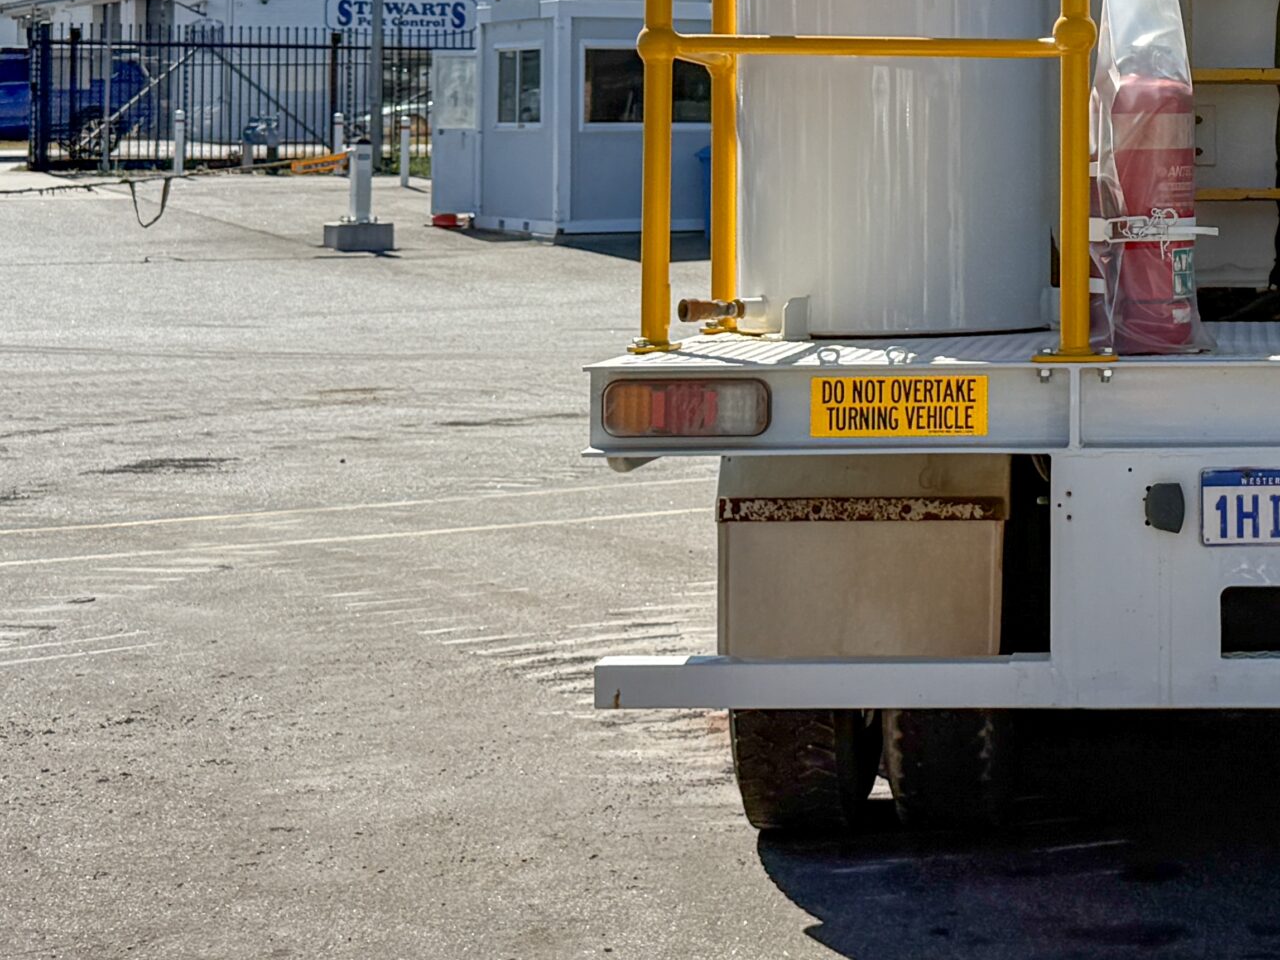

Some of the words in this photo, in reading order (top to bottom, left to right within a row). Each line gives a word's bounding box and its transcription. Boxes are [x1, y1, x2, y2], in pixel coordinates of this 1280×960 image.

[392, 16, 446, 28] Control
[822, 379, 845, 404] DO
[852, 379, 886, 404] NOT
[891, 378, 977, 404] OVERTAKE
[826, 406, 899, 431] TURNING
[905, 405, 975, 430] VEHICLE
